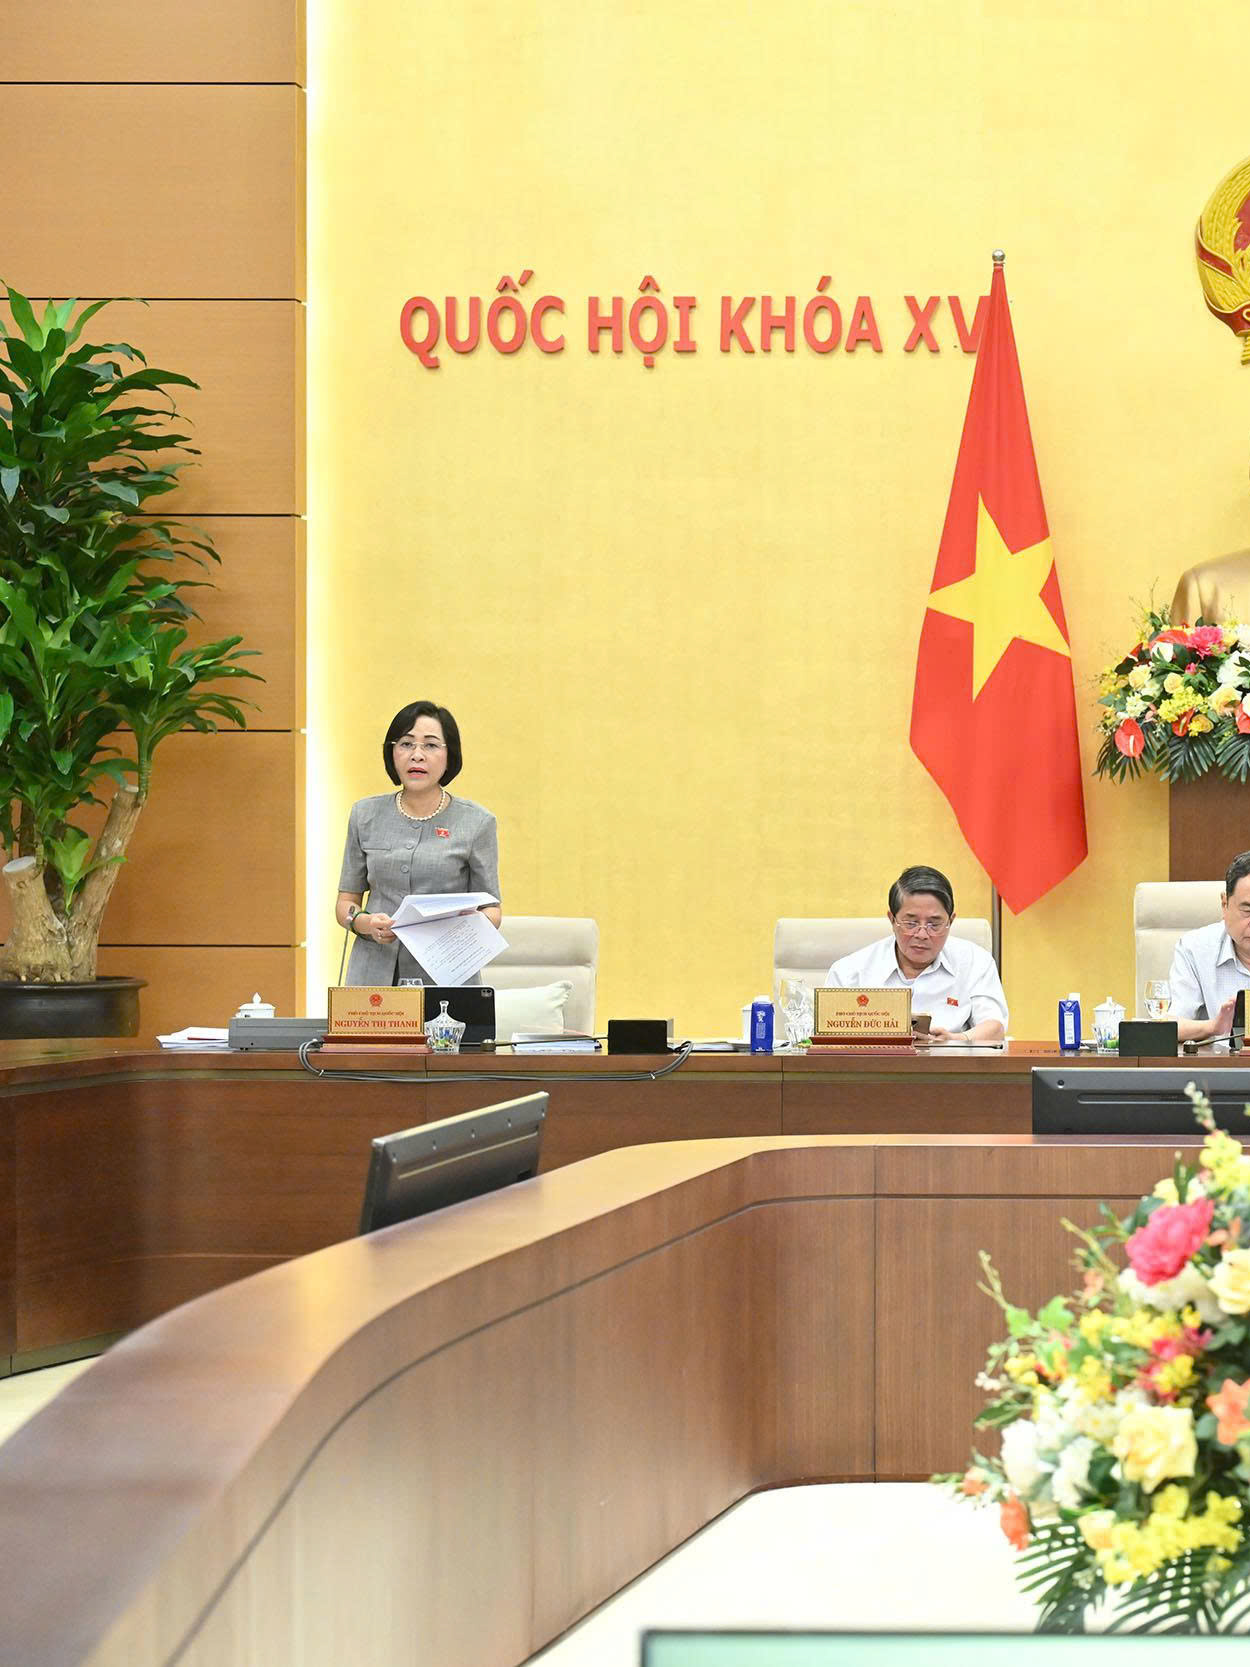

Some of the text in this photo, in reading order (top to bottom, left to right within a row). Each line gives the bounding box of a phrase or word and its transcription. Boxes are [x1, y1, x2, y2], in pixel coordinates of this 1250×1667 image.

[399, 269, 992, 369] QUỐC HỘI KHÓA XV
[388, 1020, 418, 1028] THANH
